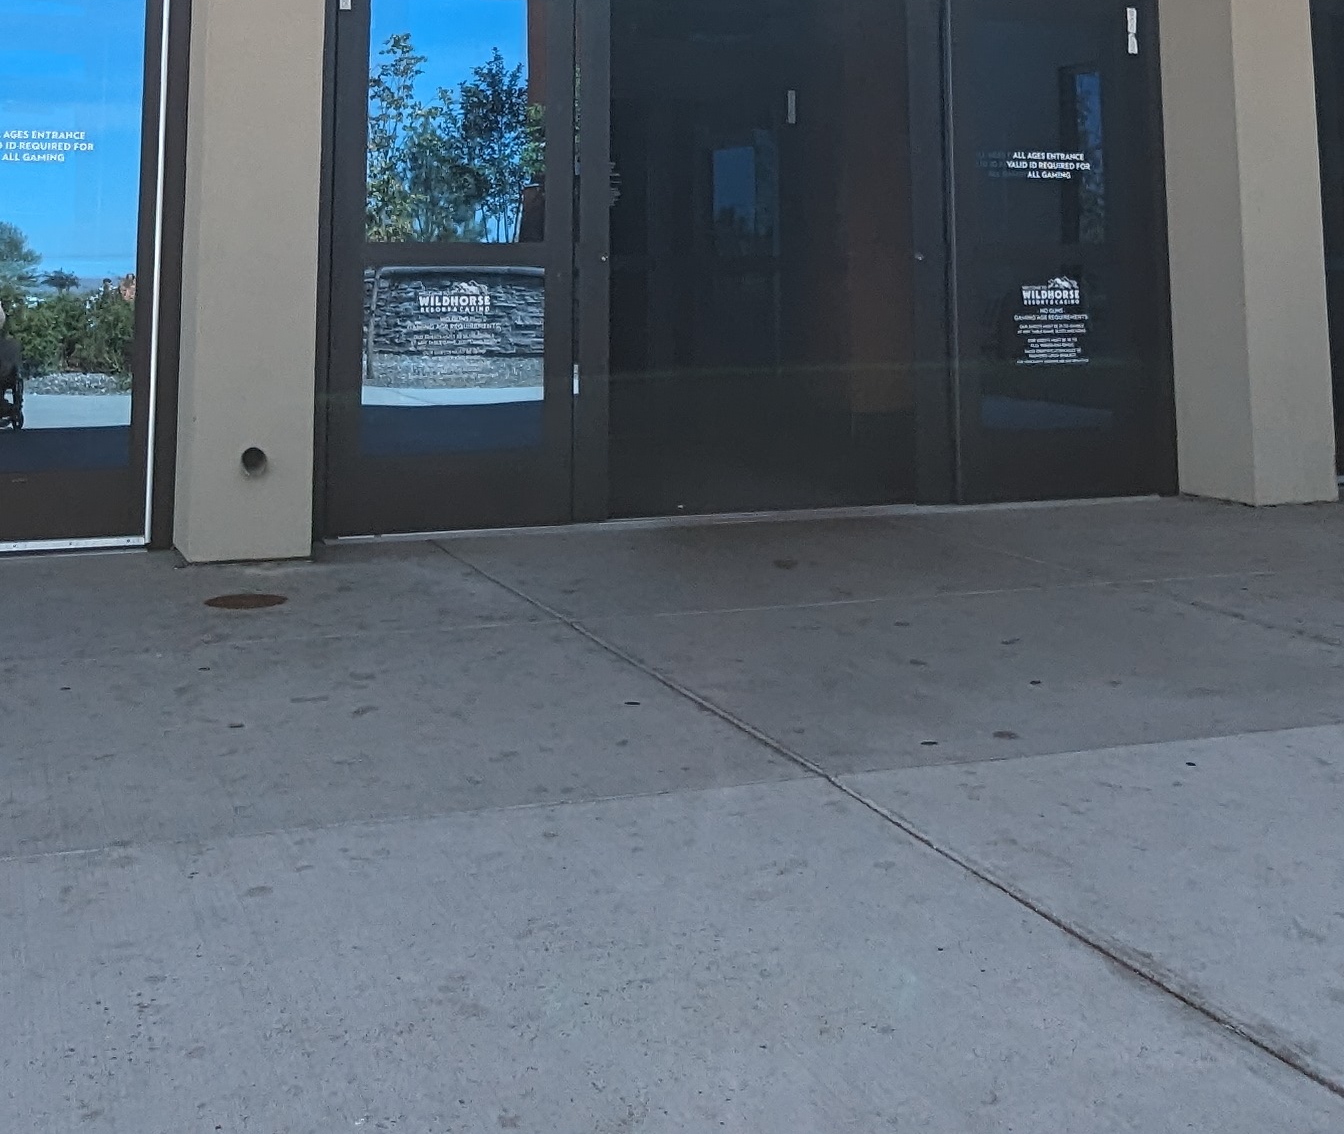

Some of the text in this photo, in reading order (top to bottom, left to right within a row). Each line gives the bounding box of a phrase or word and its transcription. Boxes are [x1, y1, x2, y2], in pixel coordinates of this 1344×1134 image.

[3, 130, 29, 140] AGES
[31, 131, 86, 140] ENTRANCE
[5, 141, 17, 150] ID
[19, 141, 71, 151] REQUIRED
[73, 142, 94, 151] FOR
[1, 152, 65, 162] ALL GAMING
[1027, 152, 1045, 160] AGES
[1046, 152, 1085, 161] ENTRANCE
[1006, 161, 1091, 170] VALID ID REQUIRED FOR
[1041, 171, 1072, 179] GAMING
[1022, 290, 1080, 299] WILDHORSE
[418, 296, 491, 306] WILDHORSE
